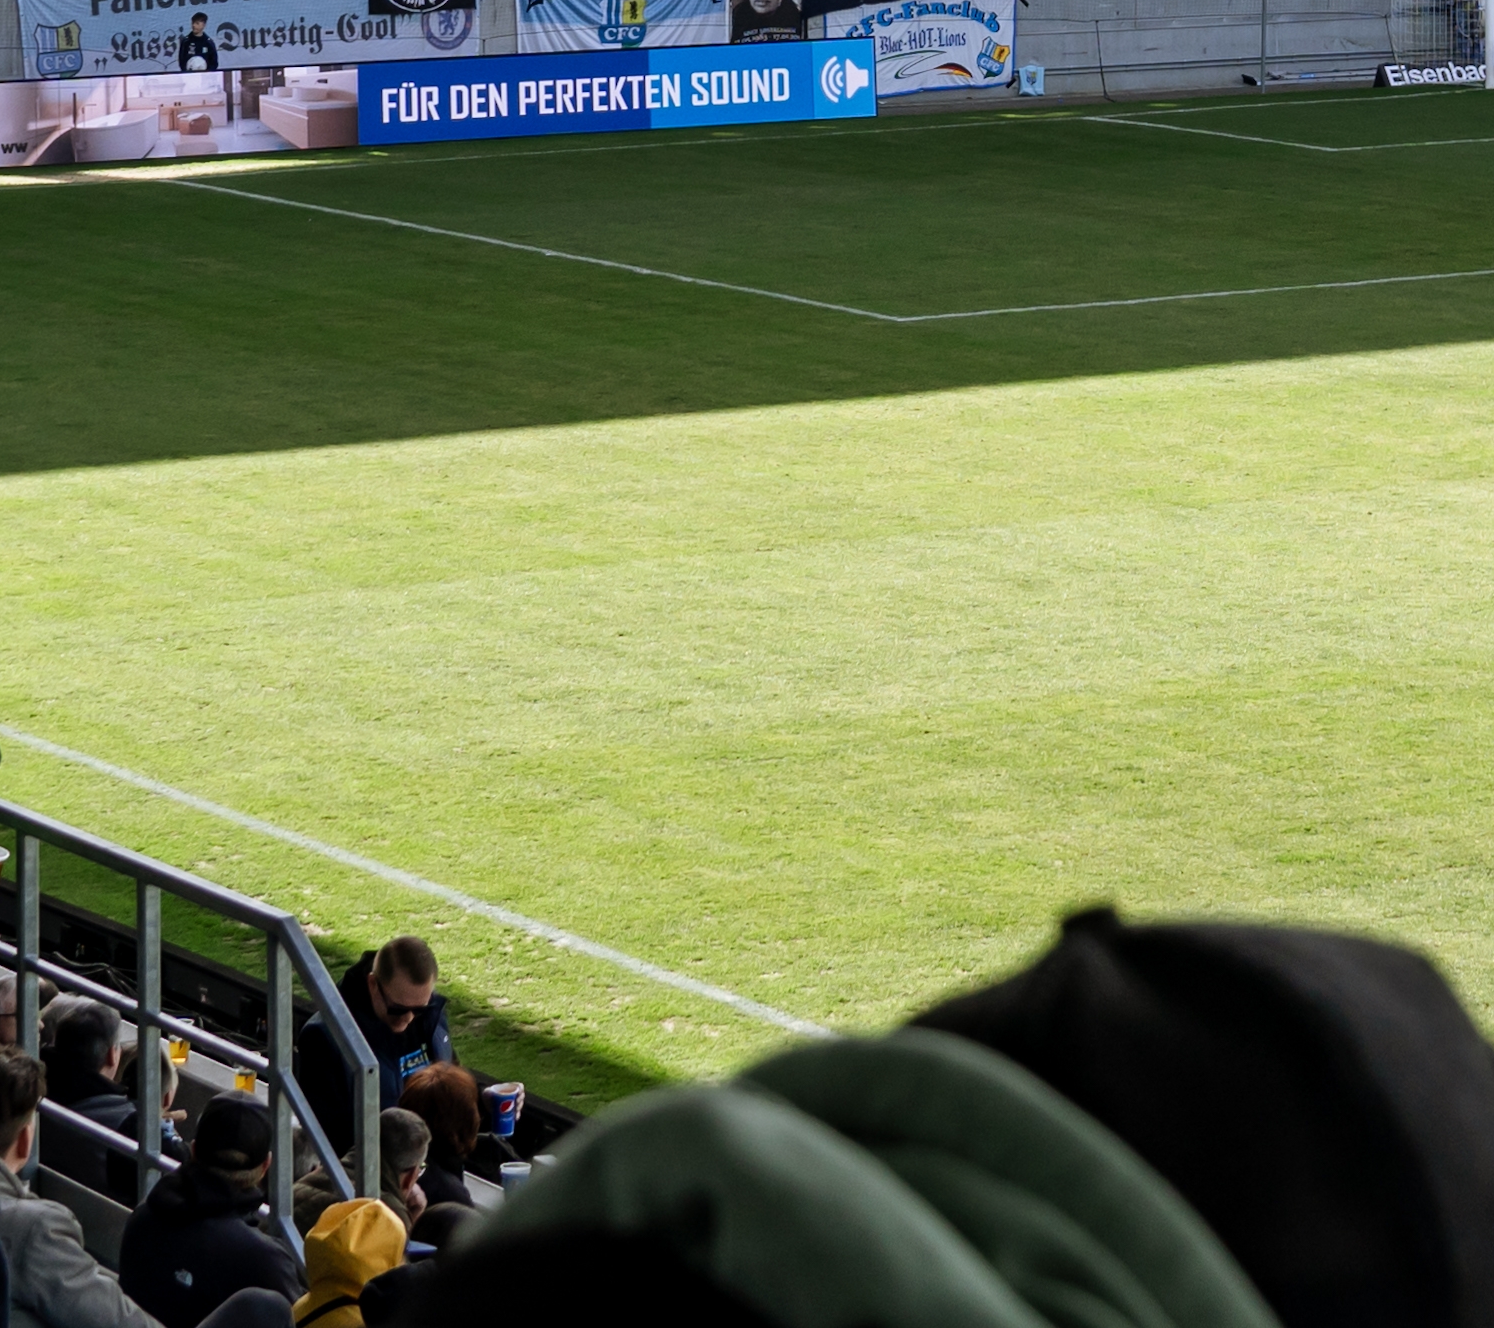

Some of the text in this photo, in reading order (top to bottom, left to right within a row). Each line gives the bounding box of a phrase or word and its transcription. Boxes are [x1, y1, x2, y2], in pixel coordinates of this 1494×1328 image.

[845, 0, 1000, 38] CFC-Fanclub
[603, 27, 642, 42] CFC
[41, 56, 76, 72] CFC
[380, 67, 791, 124] FÜR DEN PERFEKTEN SOUND
